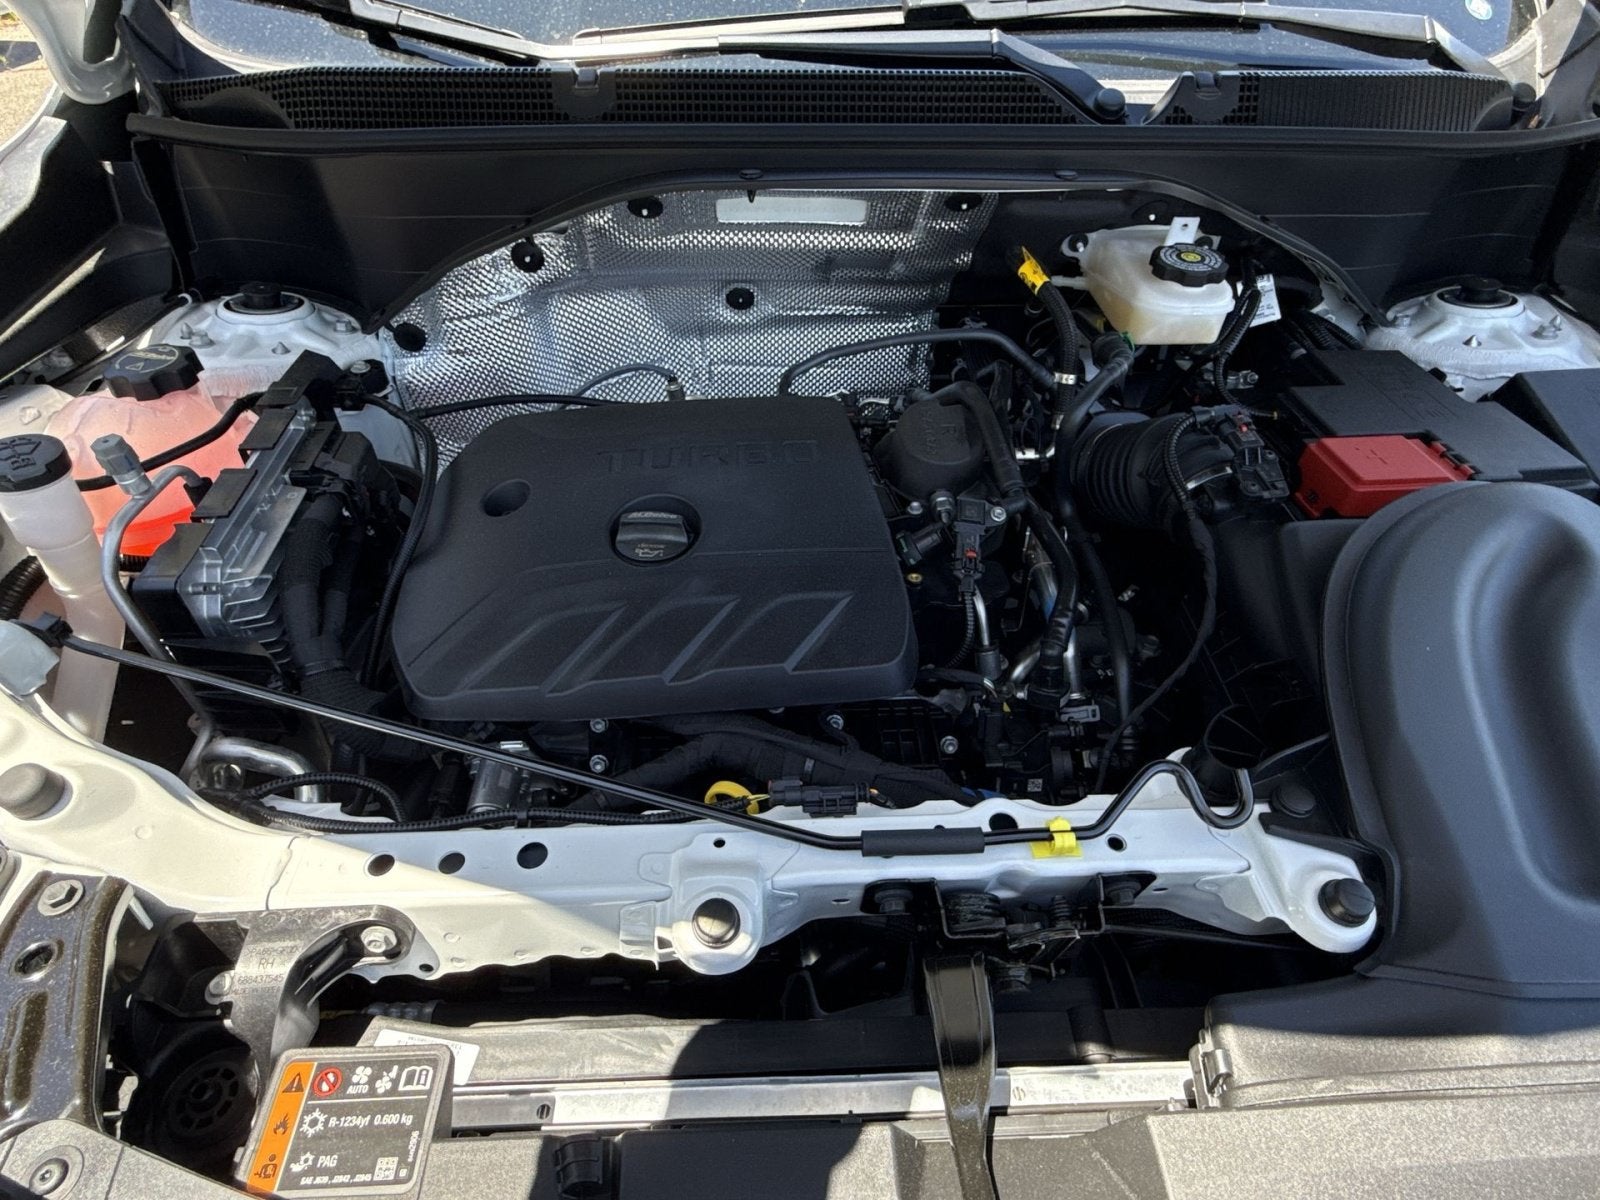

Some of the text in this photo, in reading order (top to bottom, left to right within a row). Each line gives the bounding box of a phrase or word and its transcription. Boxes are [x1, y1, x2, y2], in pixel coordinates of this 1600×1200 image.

[597, 439, 820, 473] TURBO
[258, 957, 276, 970] RH
[346, 1084, 369, 1095] AUTO
[327, 1112, 414, 1129] R-1234yf 0.600 kg
[316, 1155, 338, 1168] PAG
